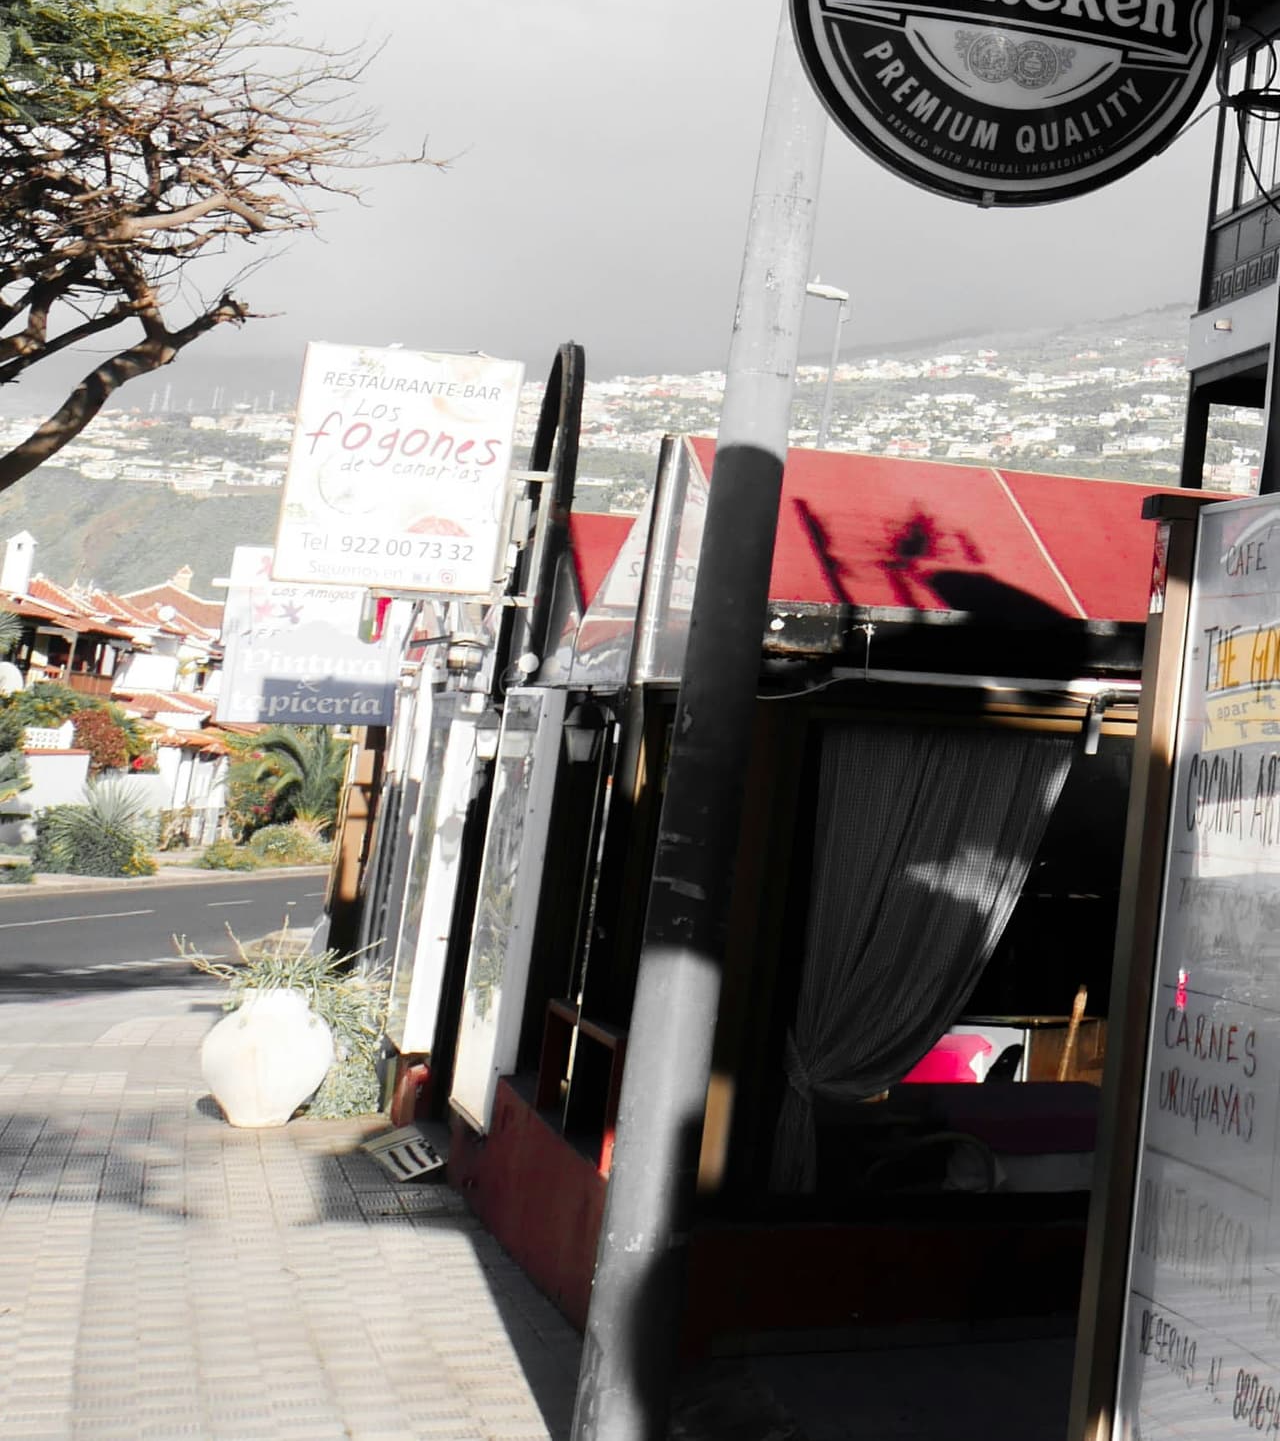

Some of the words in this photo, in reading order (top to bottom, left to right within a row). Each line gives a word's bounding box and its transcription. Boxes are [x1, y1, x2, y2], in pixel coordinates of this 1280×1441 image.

[864, 40, 999, 151] PREMIUM
[1016, 77, 1143, 154] QUALITY
[322, 370, 503, 402] RESTAURANTE-BAR
[304, 410, 502, 468] fogones
[340, 454, 367, 473] de
[340, 535, 380, 556] 922
[385, 539, 412, 558] 00
[417, 541, 443, 559] 73
[447, 543, 475, 562] 32
[241, 647, 383, 676] Pintura
[232, 689, 384, 717] tapicería
[1187, 750, 1243, 839] COCINA
[1164, 1007, 1256, 1078] CARNES
[1159, 1066, 1256, 1142] URUGUAYAS
